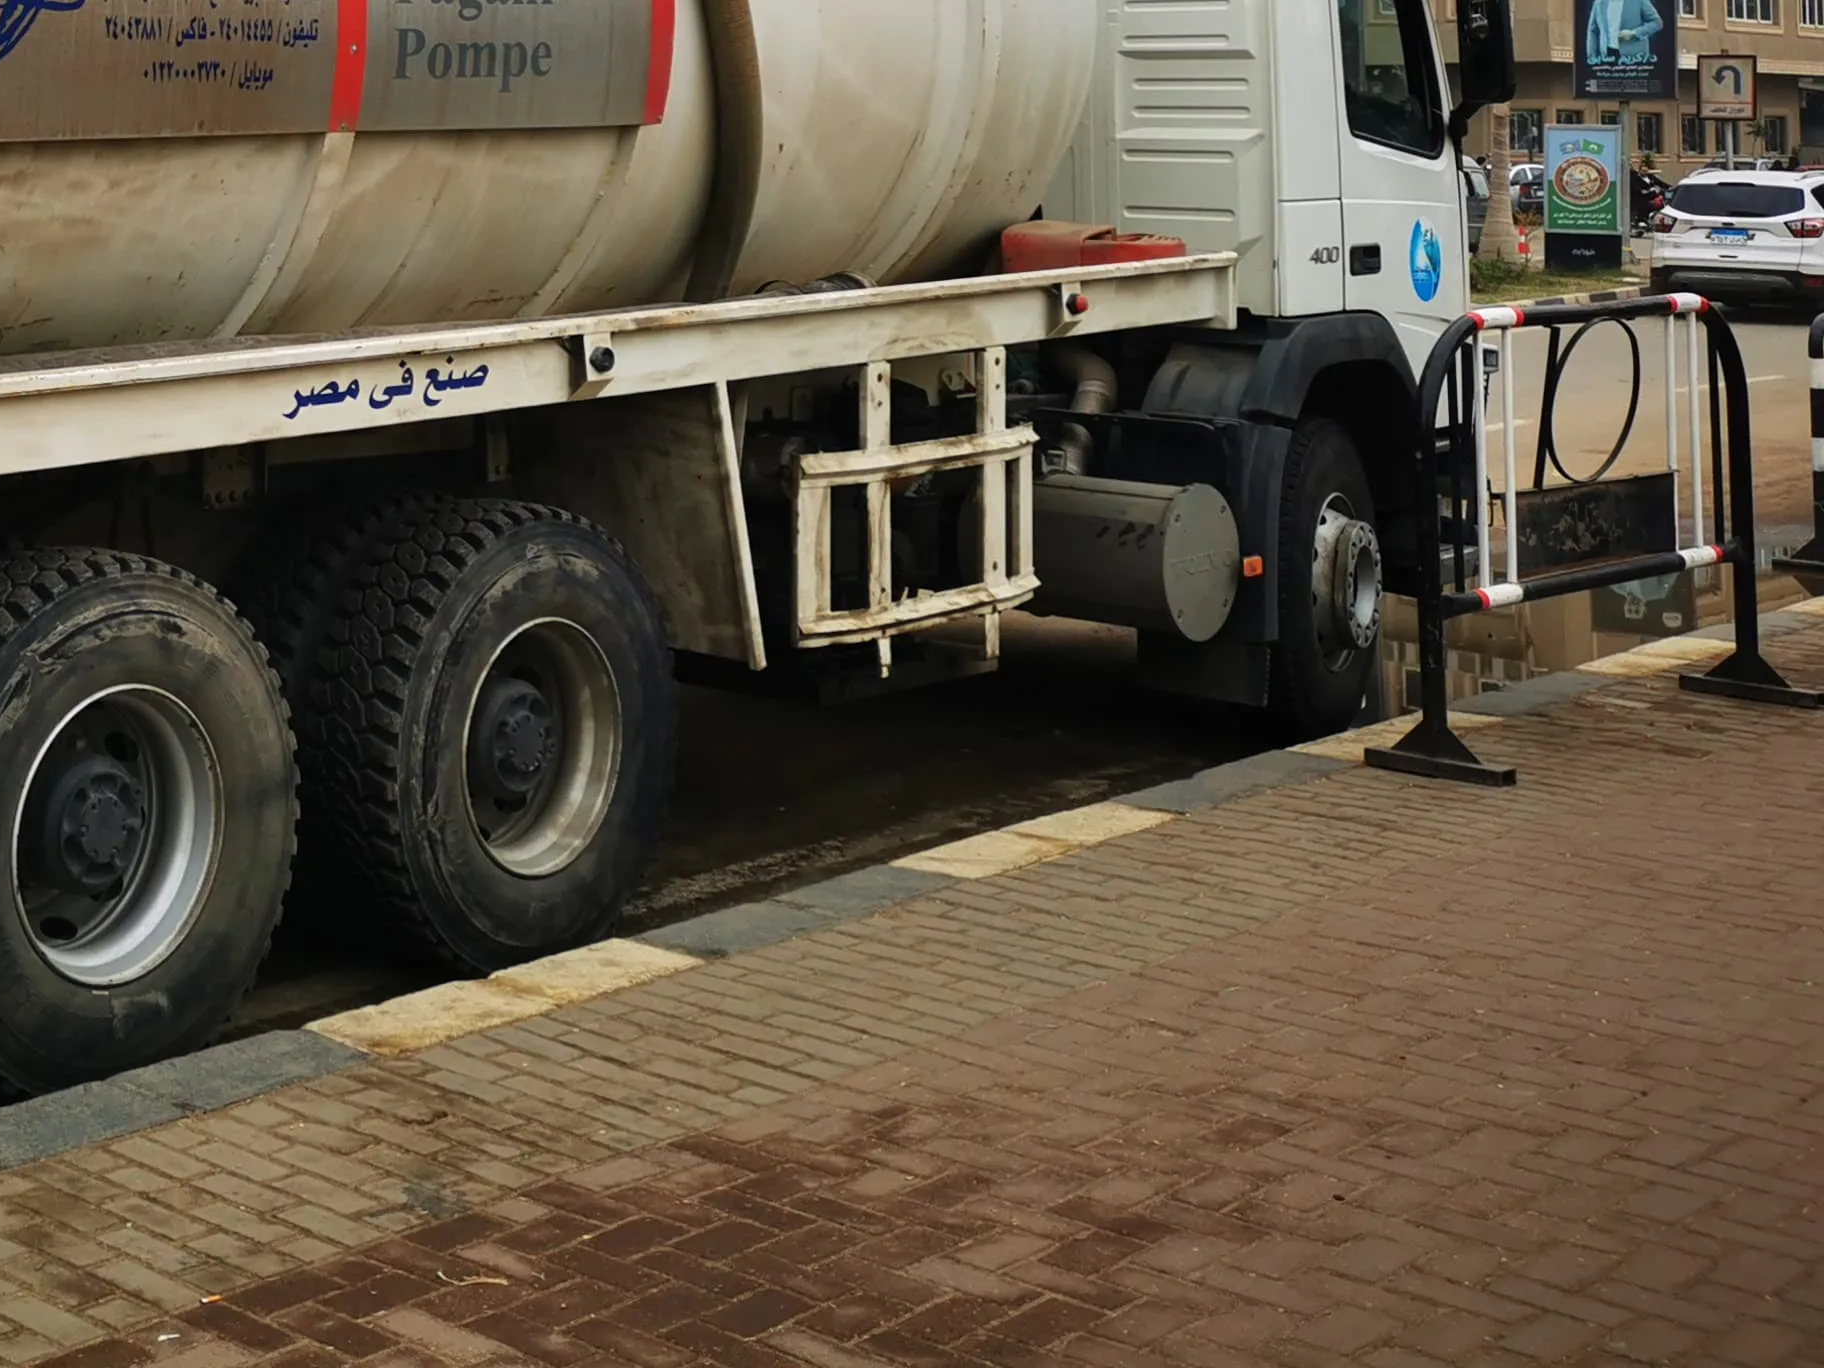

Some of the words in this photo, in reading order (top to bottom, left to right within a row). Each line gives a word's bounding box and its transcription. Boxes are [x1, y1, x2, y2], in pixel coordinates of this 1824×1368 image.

[391, 28, 553, 94] Pompe
[1309, 245, 1341, 265] 400
[282, 378, 360, 420] مصر
[422, 354, 489, 407] صنع
